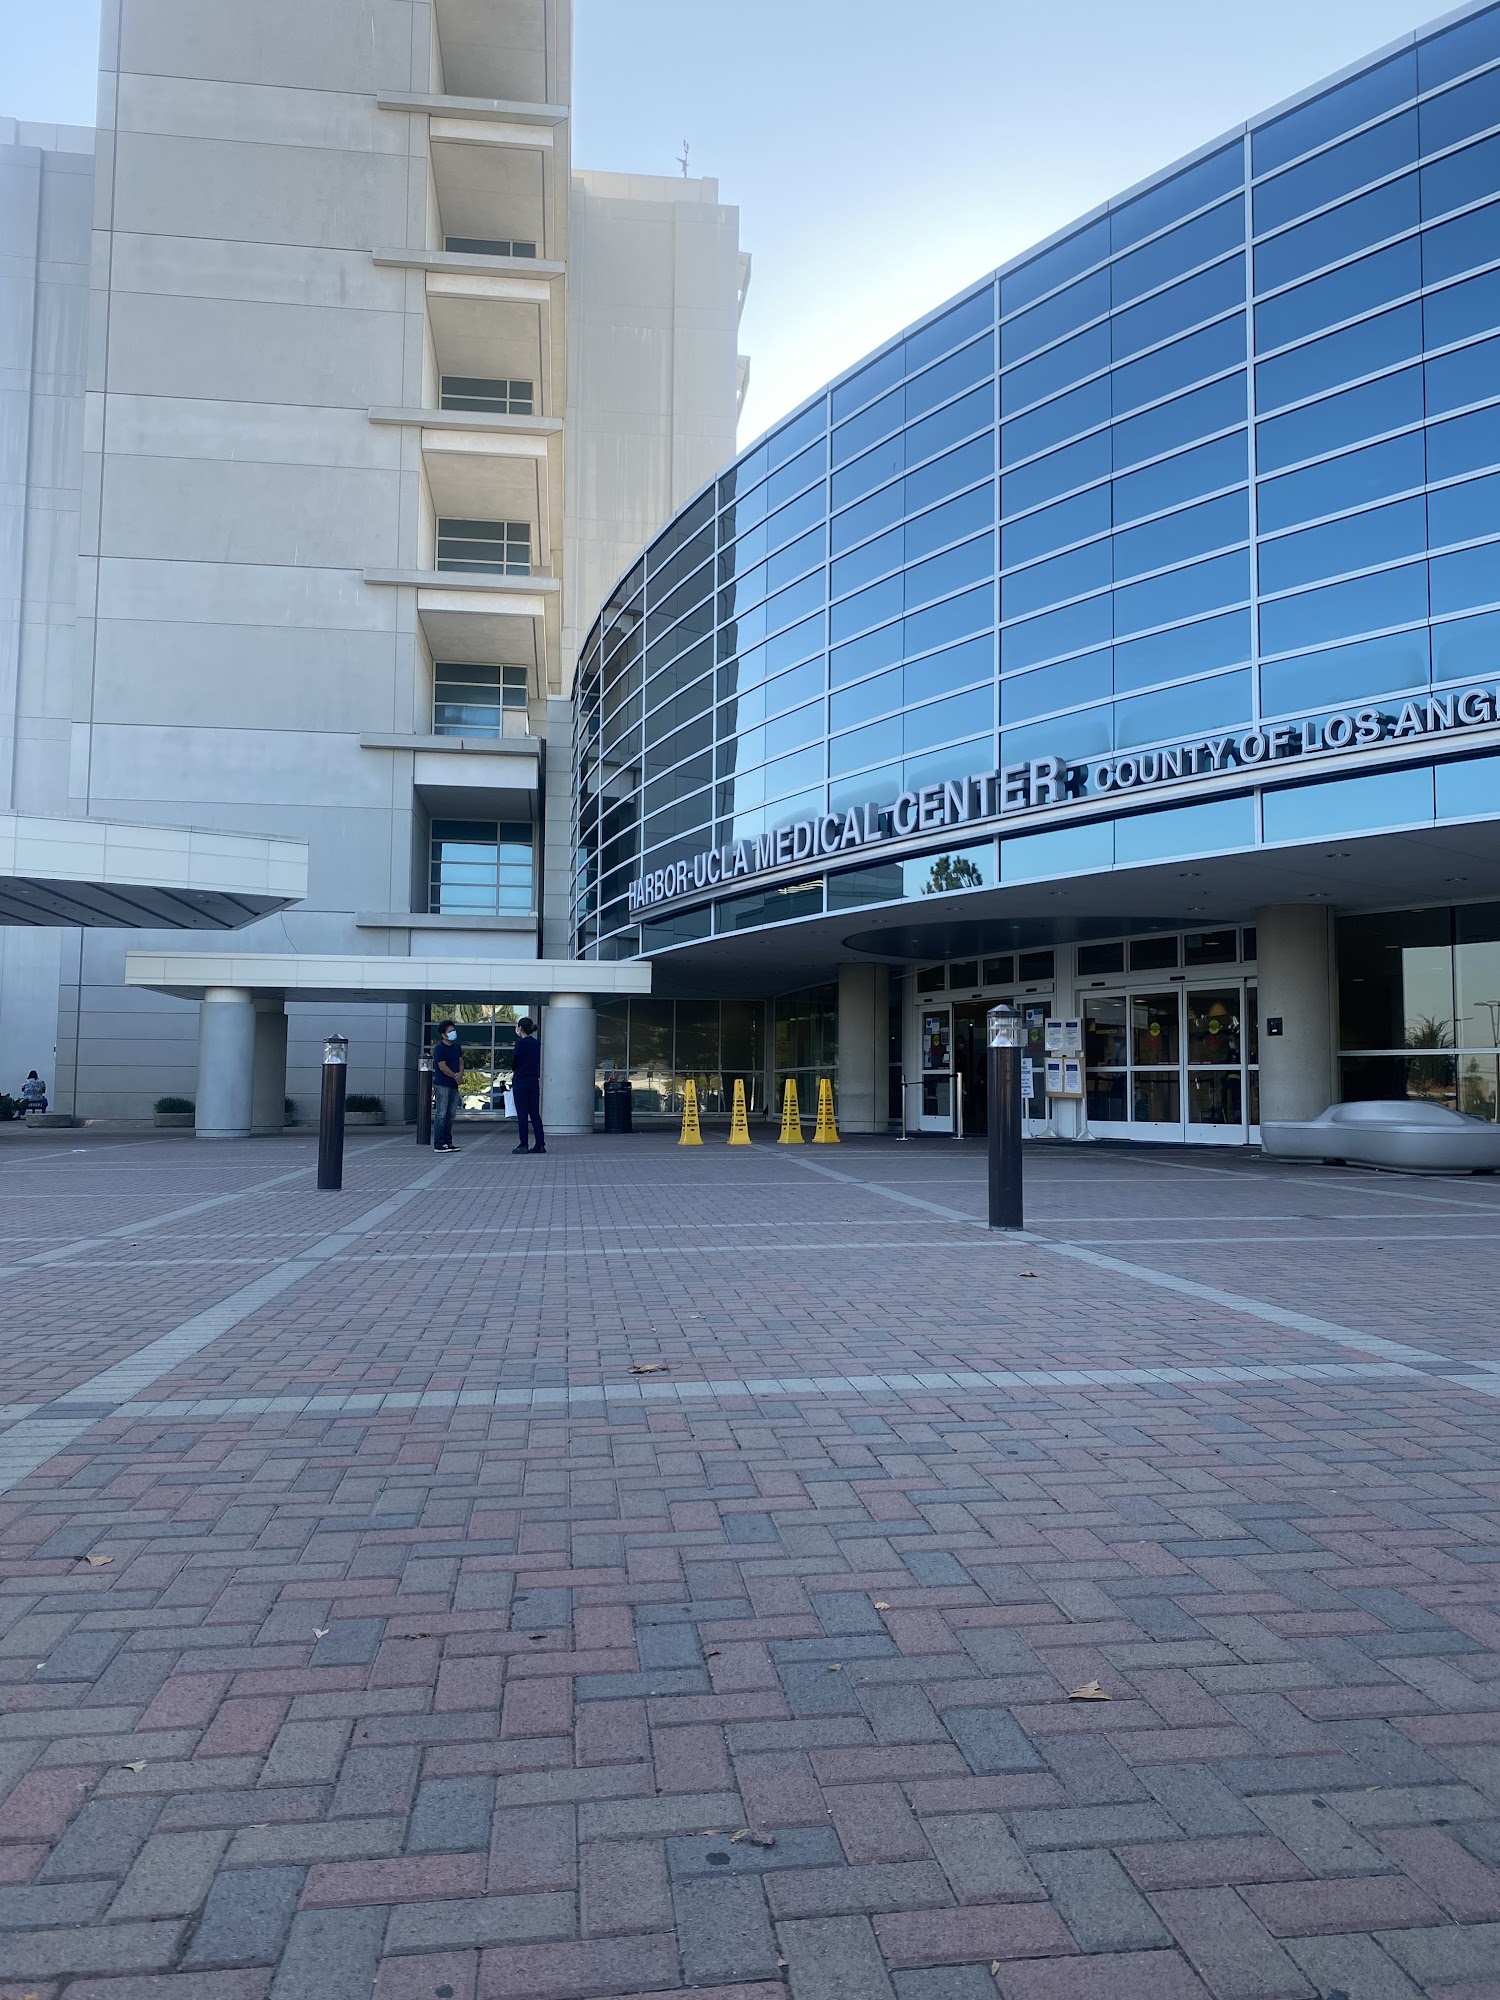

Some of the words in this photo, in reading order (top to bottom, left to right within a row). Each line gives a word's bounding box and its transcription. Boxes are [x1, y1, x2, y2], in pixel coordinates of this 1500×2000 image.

[628, 839, 751, 911] HARBOR-UCLA
[755, 801, 882, 871] MEDICAL
[893, 755, 1065, 836] CENTER
[1095, 738, 1229, 792] COUNTY
[1240, 725, 1296, 763] OF
[1301, 708, 1385, 753] LOS
[1394, 686, 1500, 737] ANG
